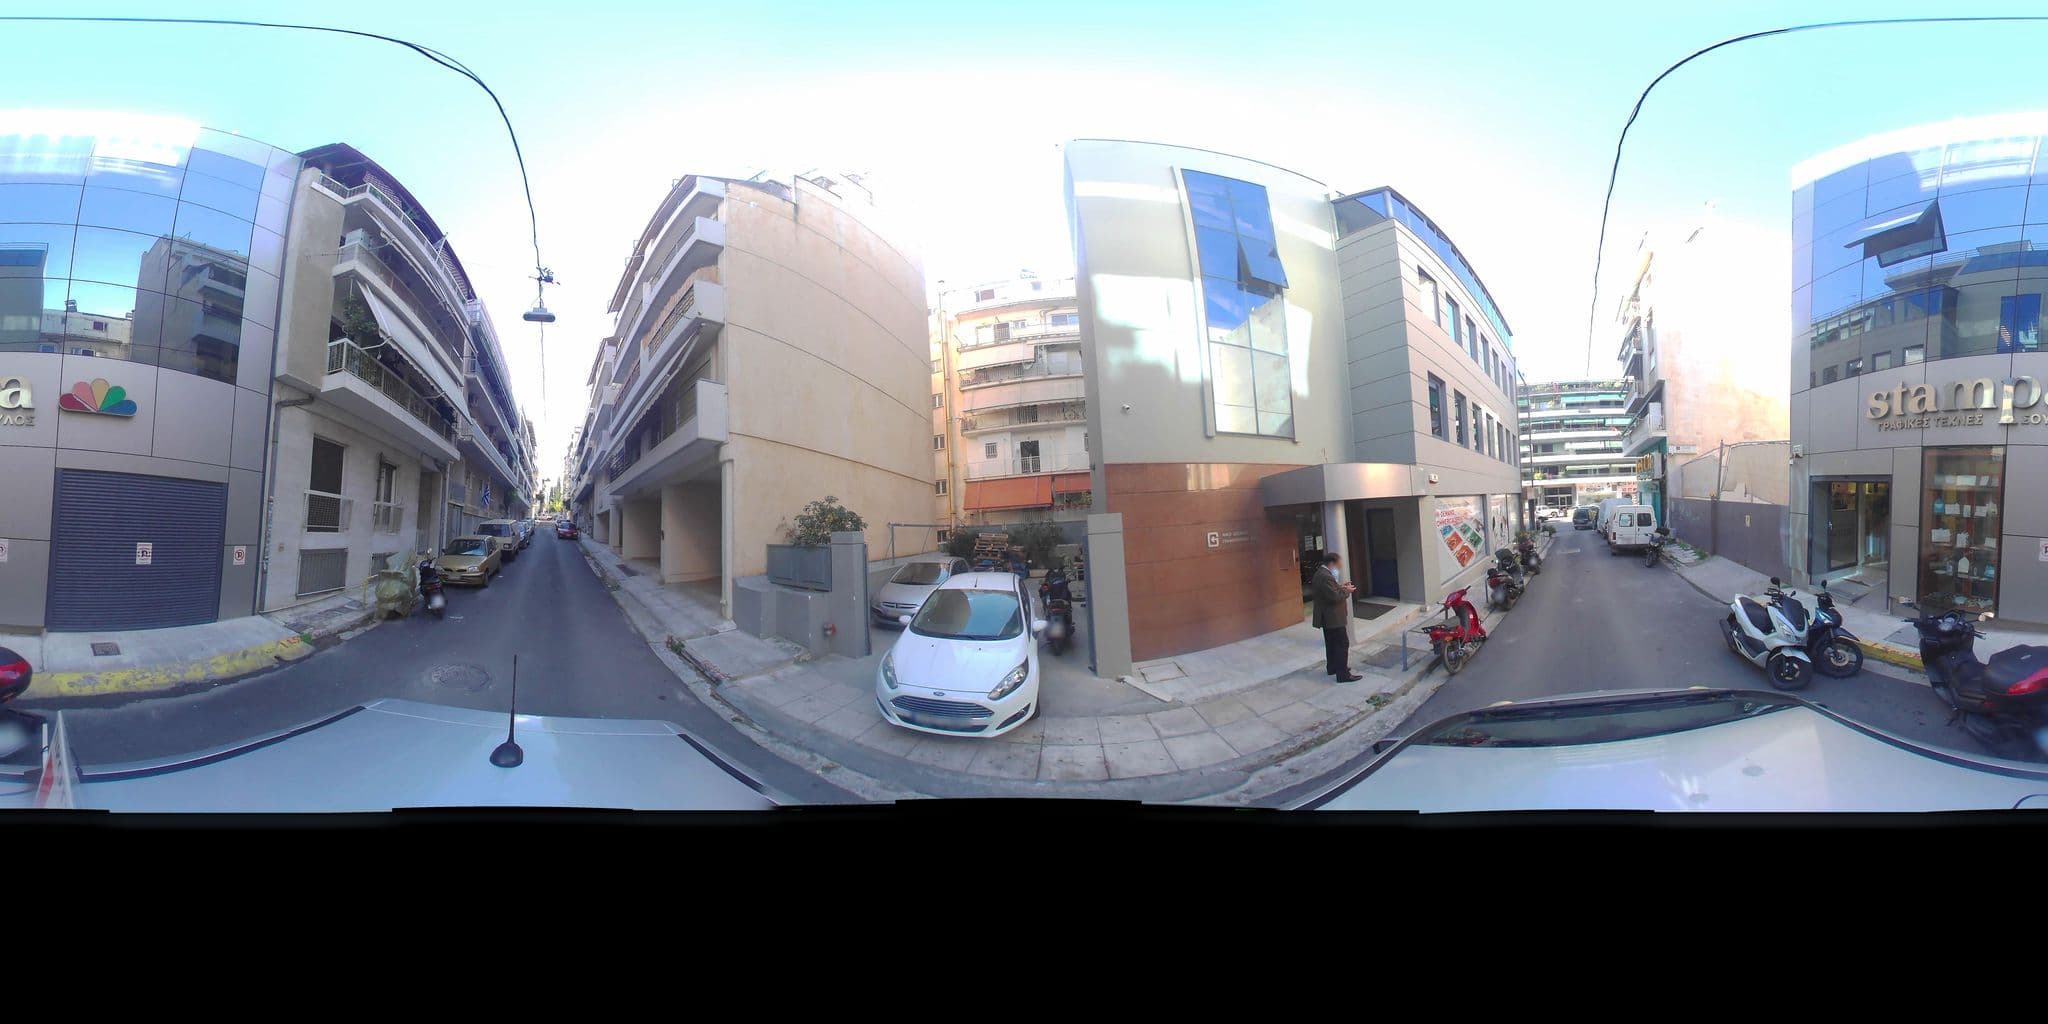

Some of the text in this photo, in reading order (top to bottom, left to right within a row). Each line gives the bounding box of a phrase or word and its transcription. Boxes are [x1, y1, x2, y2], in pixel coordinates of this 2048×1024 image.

[1864, 375, 2048, 425] stamp
[1878, 417, 1930, 432] ΓΡΑΦΙΚΕΣ
[1935, 414, 1984, 428] ΤΕΧΝΕΣ
